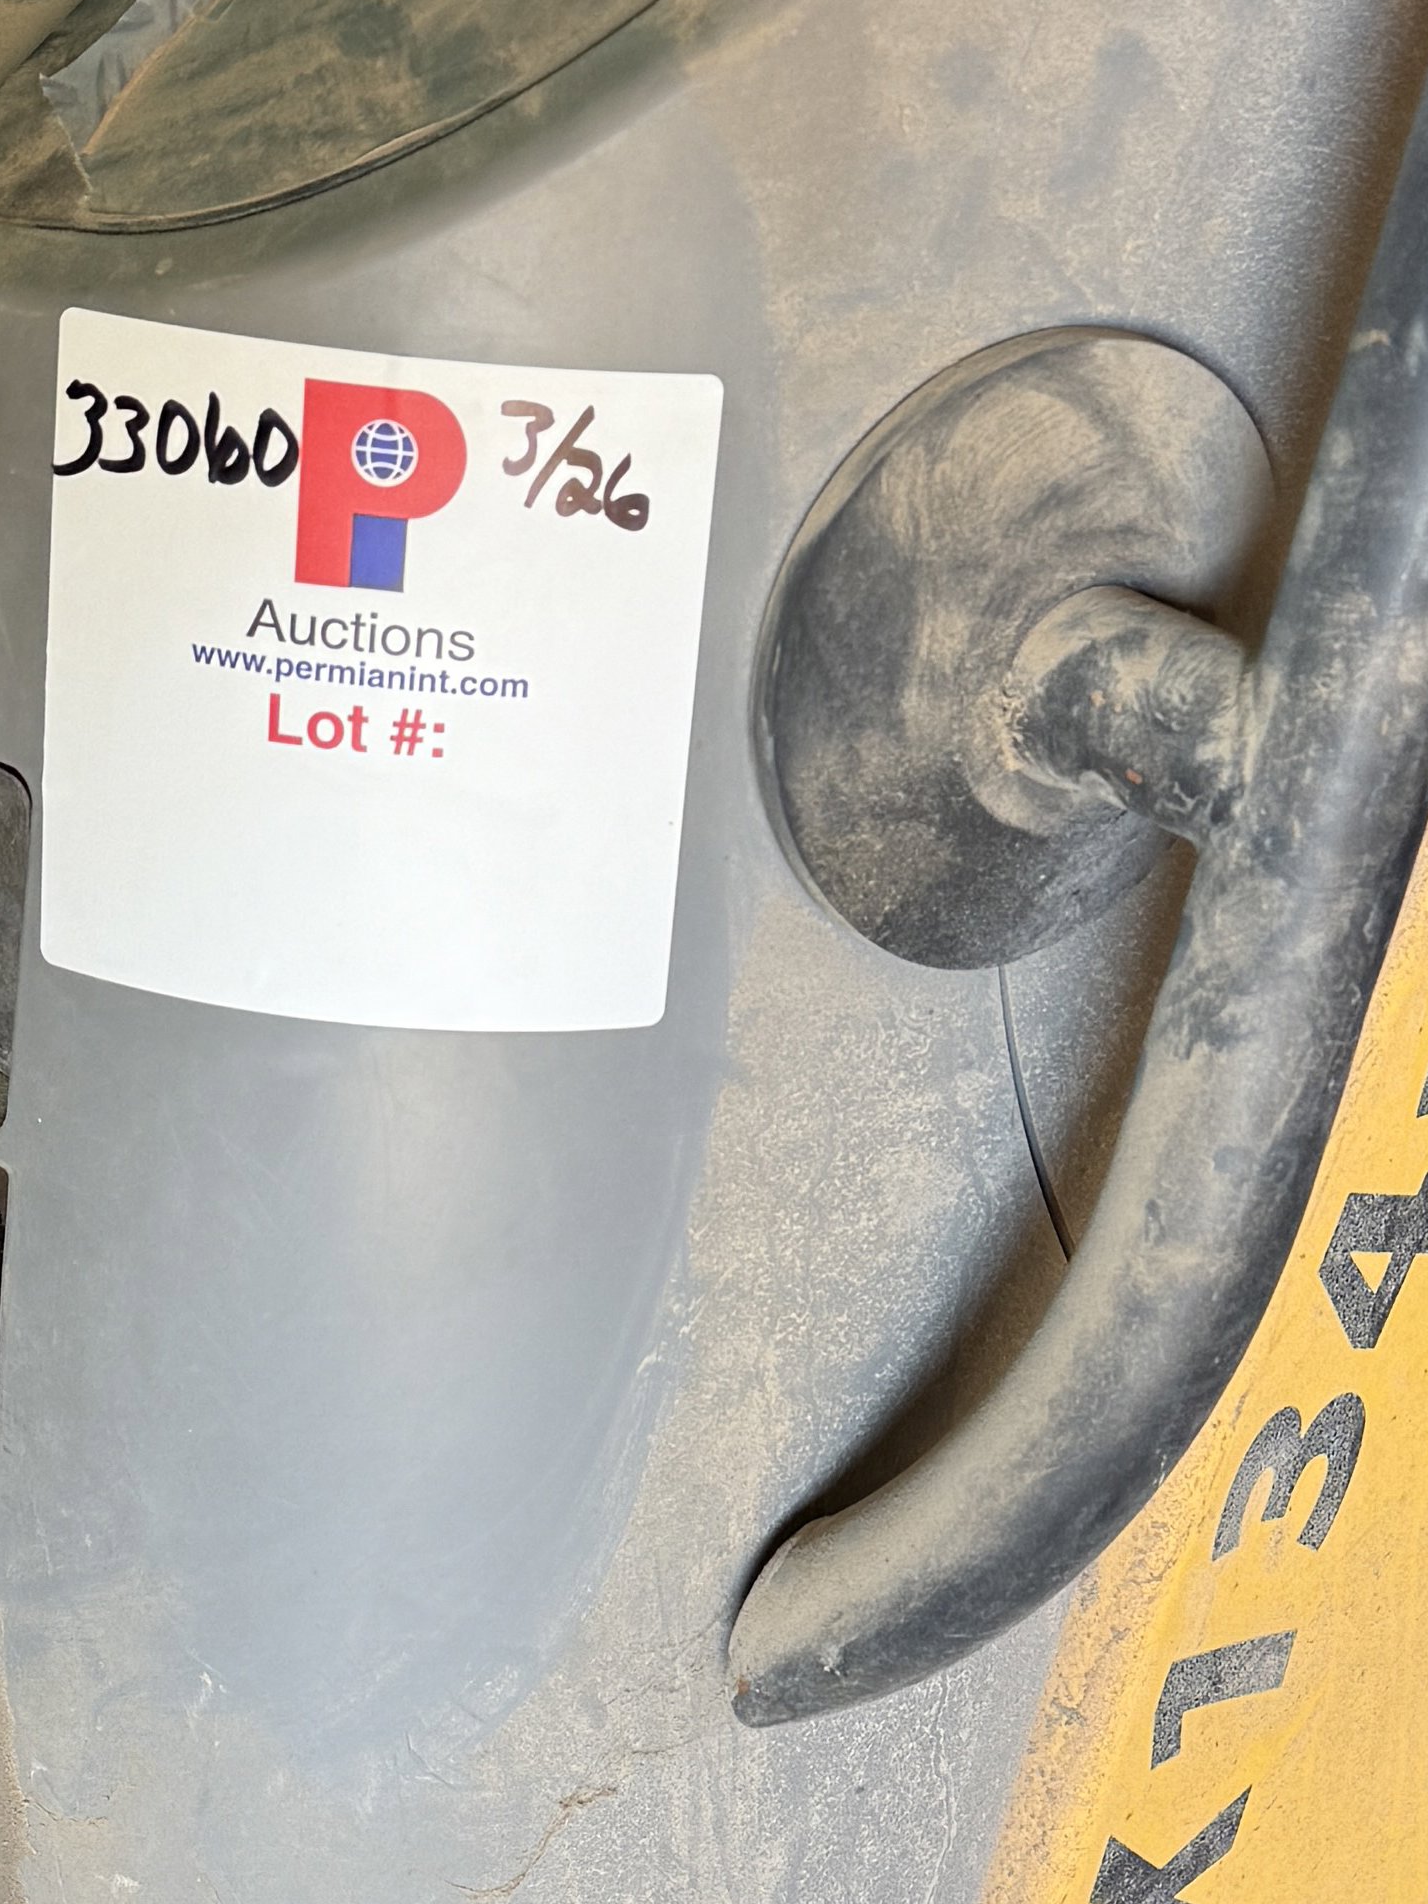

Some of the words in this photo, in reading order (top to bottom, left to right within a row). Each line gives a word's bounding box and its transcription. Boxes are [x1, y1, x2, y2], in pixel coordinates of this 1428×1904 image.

[53, 379, 300, 487] 33060
[500, 398, 651, 532] 3/26
[245, 598, 477, 663] Auctions
[191, 640, 530, 700] www.permianint.com
[267, 692, 369, 754] Lot
[389, 706, 446, 759] #:
